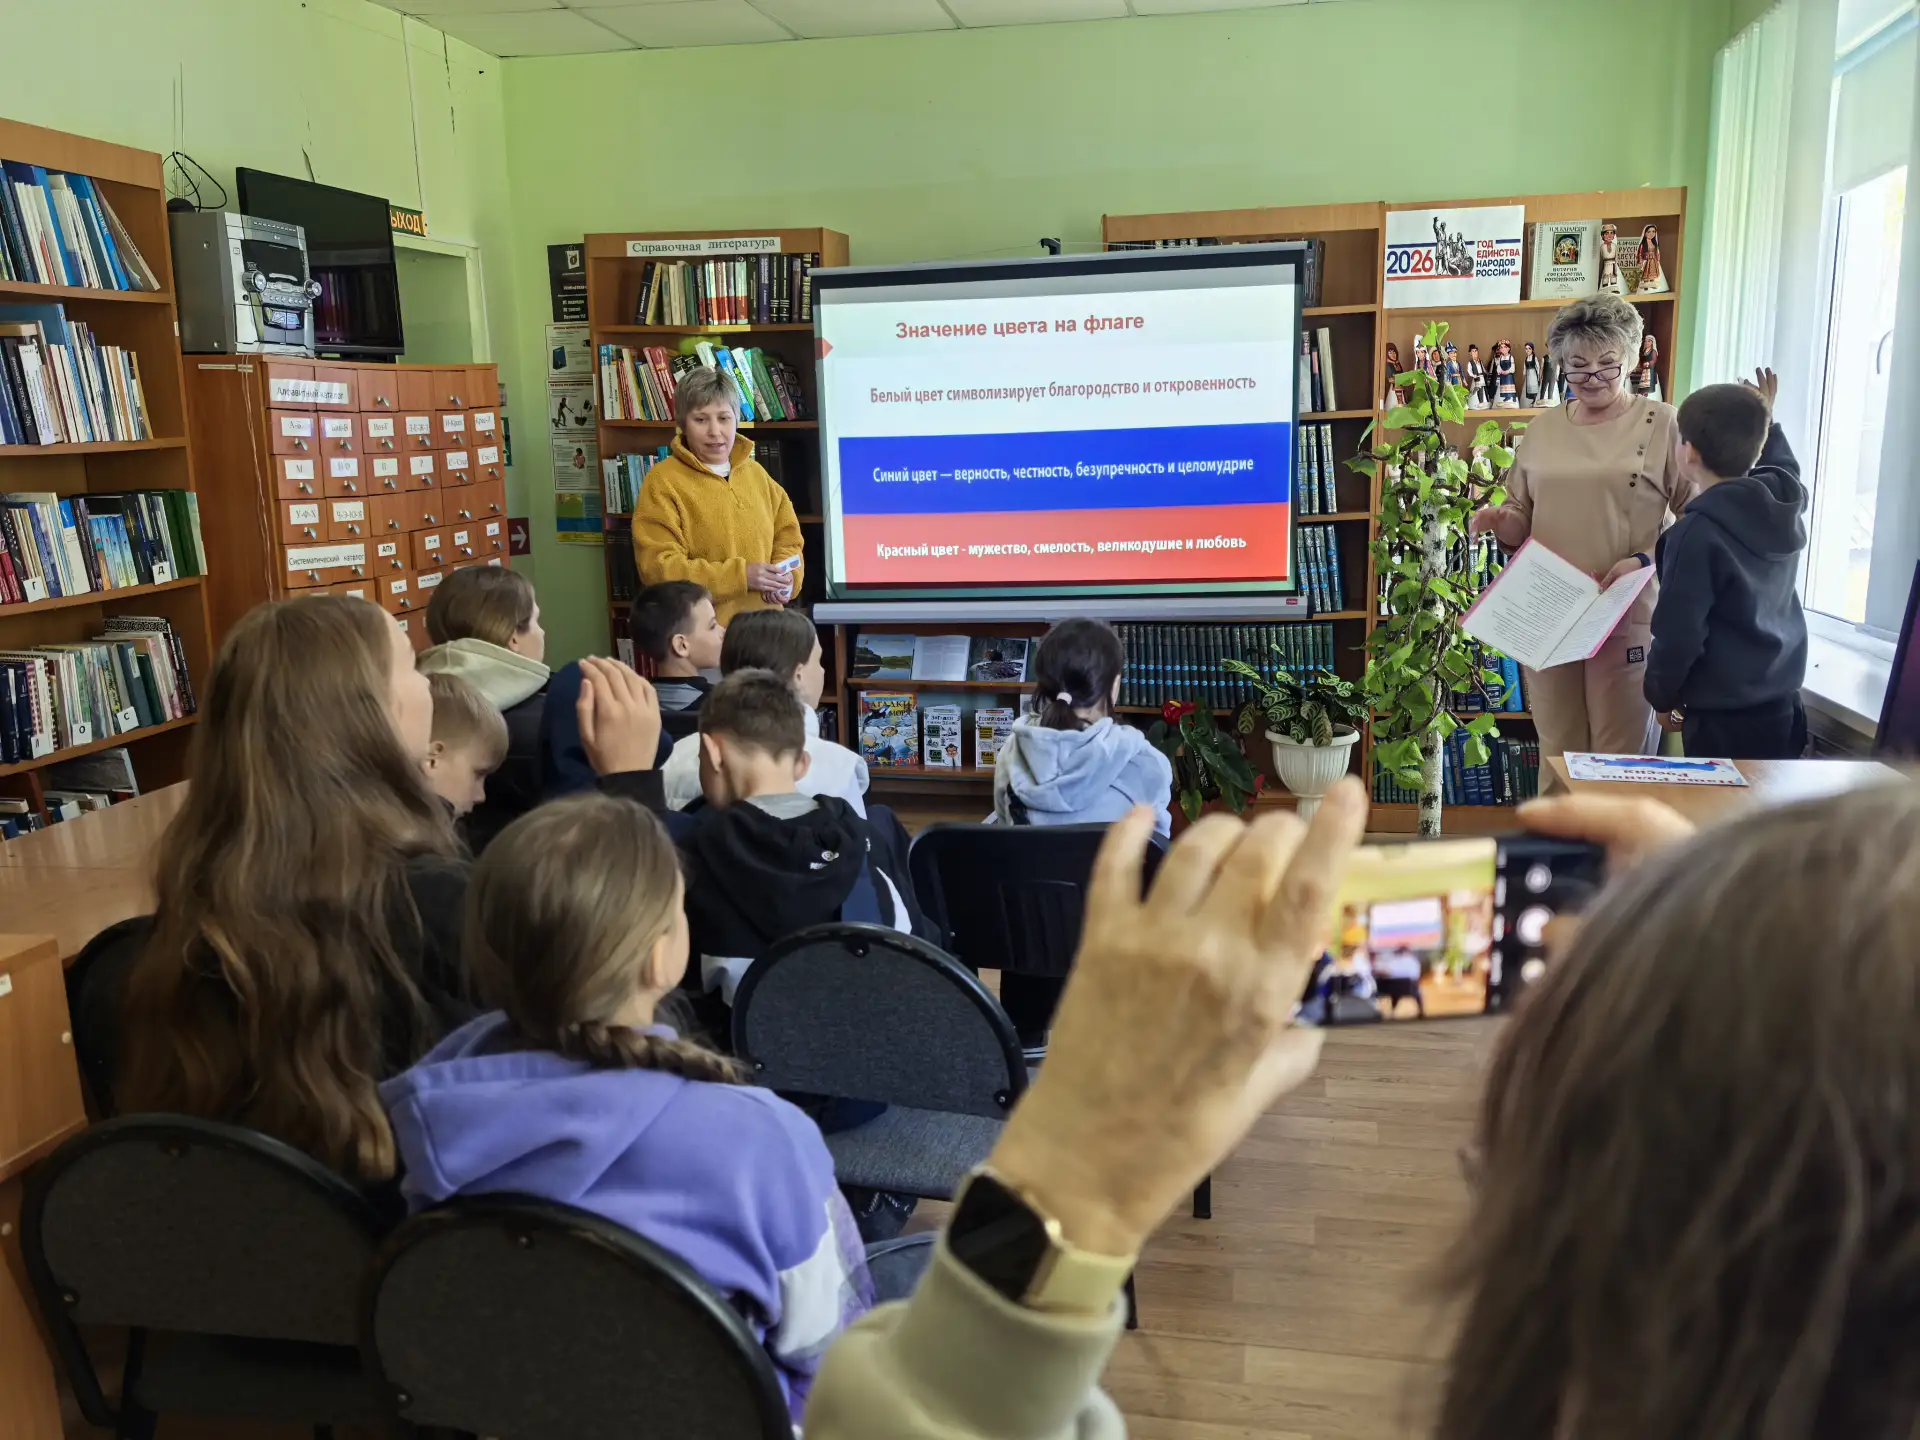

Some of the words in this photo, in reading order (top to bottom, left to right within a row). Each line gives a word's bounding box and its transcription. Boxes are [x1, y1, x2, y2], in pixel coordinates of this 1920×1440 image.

[389, 210, 421, 234] ЫХОД
[632, 242, 701, 255] Справочная
[708, 238, 775, 250] литература
[1477, 240, 1493, 250] ГОД
[1476, 249, 1520, 259] ЕДИНСТВА
[1387, 249, 1434, 274] 2026
[1476, 259, 1516, 268] НАРОДОВ
[1476, 269, 1510, 277] РОССИИ
[895, 322, 988, 339] Значение
[993, 320, 1048, 338] цвета
[1055, 319, 1077, 333] на
[1083, 314, 1145, 335] флаге
[277, 387, 319, 398] Алфавитный
[320, 390, 343, 400] каталог
[870, 387, 912, 403] Белый
[914, 389, 944, 405] цвет
[946, 386, 1047, 403] символизирует
[1048, 381, 1140, 399] благородство
[1142, 381, 1151, 394] и
[1154, 377, 1257, 395] откровенность
[872, 467, 910, 483] Синий
[911, 469, 938, 485] цвет
[954, 468, 1011, 484] верность,
[1013, 466, 1073, 479] честность,
[1075, 461, 1165, 480] безупречность
[1167, 462, 1176, 473] и
[1177, 458, 1254, 476] целомудрие
[876, 543, 929, 559] Красный
[930, 545, 960, 558] цвет
[968, 543, 1032, 559] мужество,
[1033, 542, 1095, 555] смелость,
[1097, 539, 1183, 554] великодушие
[1185, 538, 1194, 550] и
[1195, 535, 1247, 549] любовь
[289, 554, 340, 566] Систематический
[343, 554, 365, 562] каталог
[157, 566, 165, 576] Д
[123, 712, 130, 721] С
[79, 725, 86, 734] О
